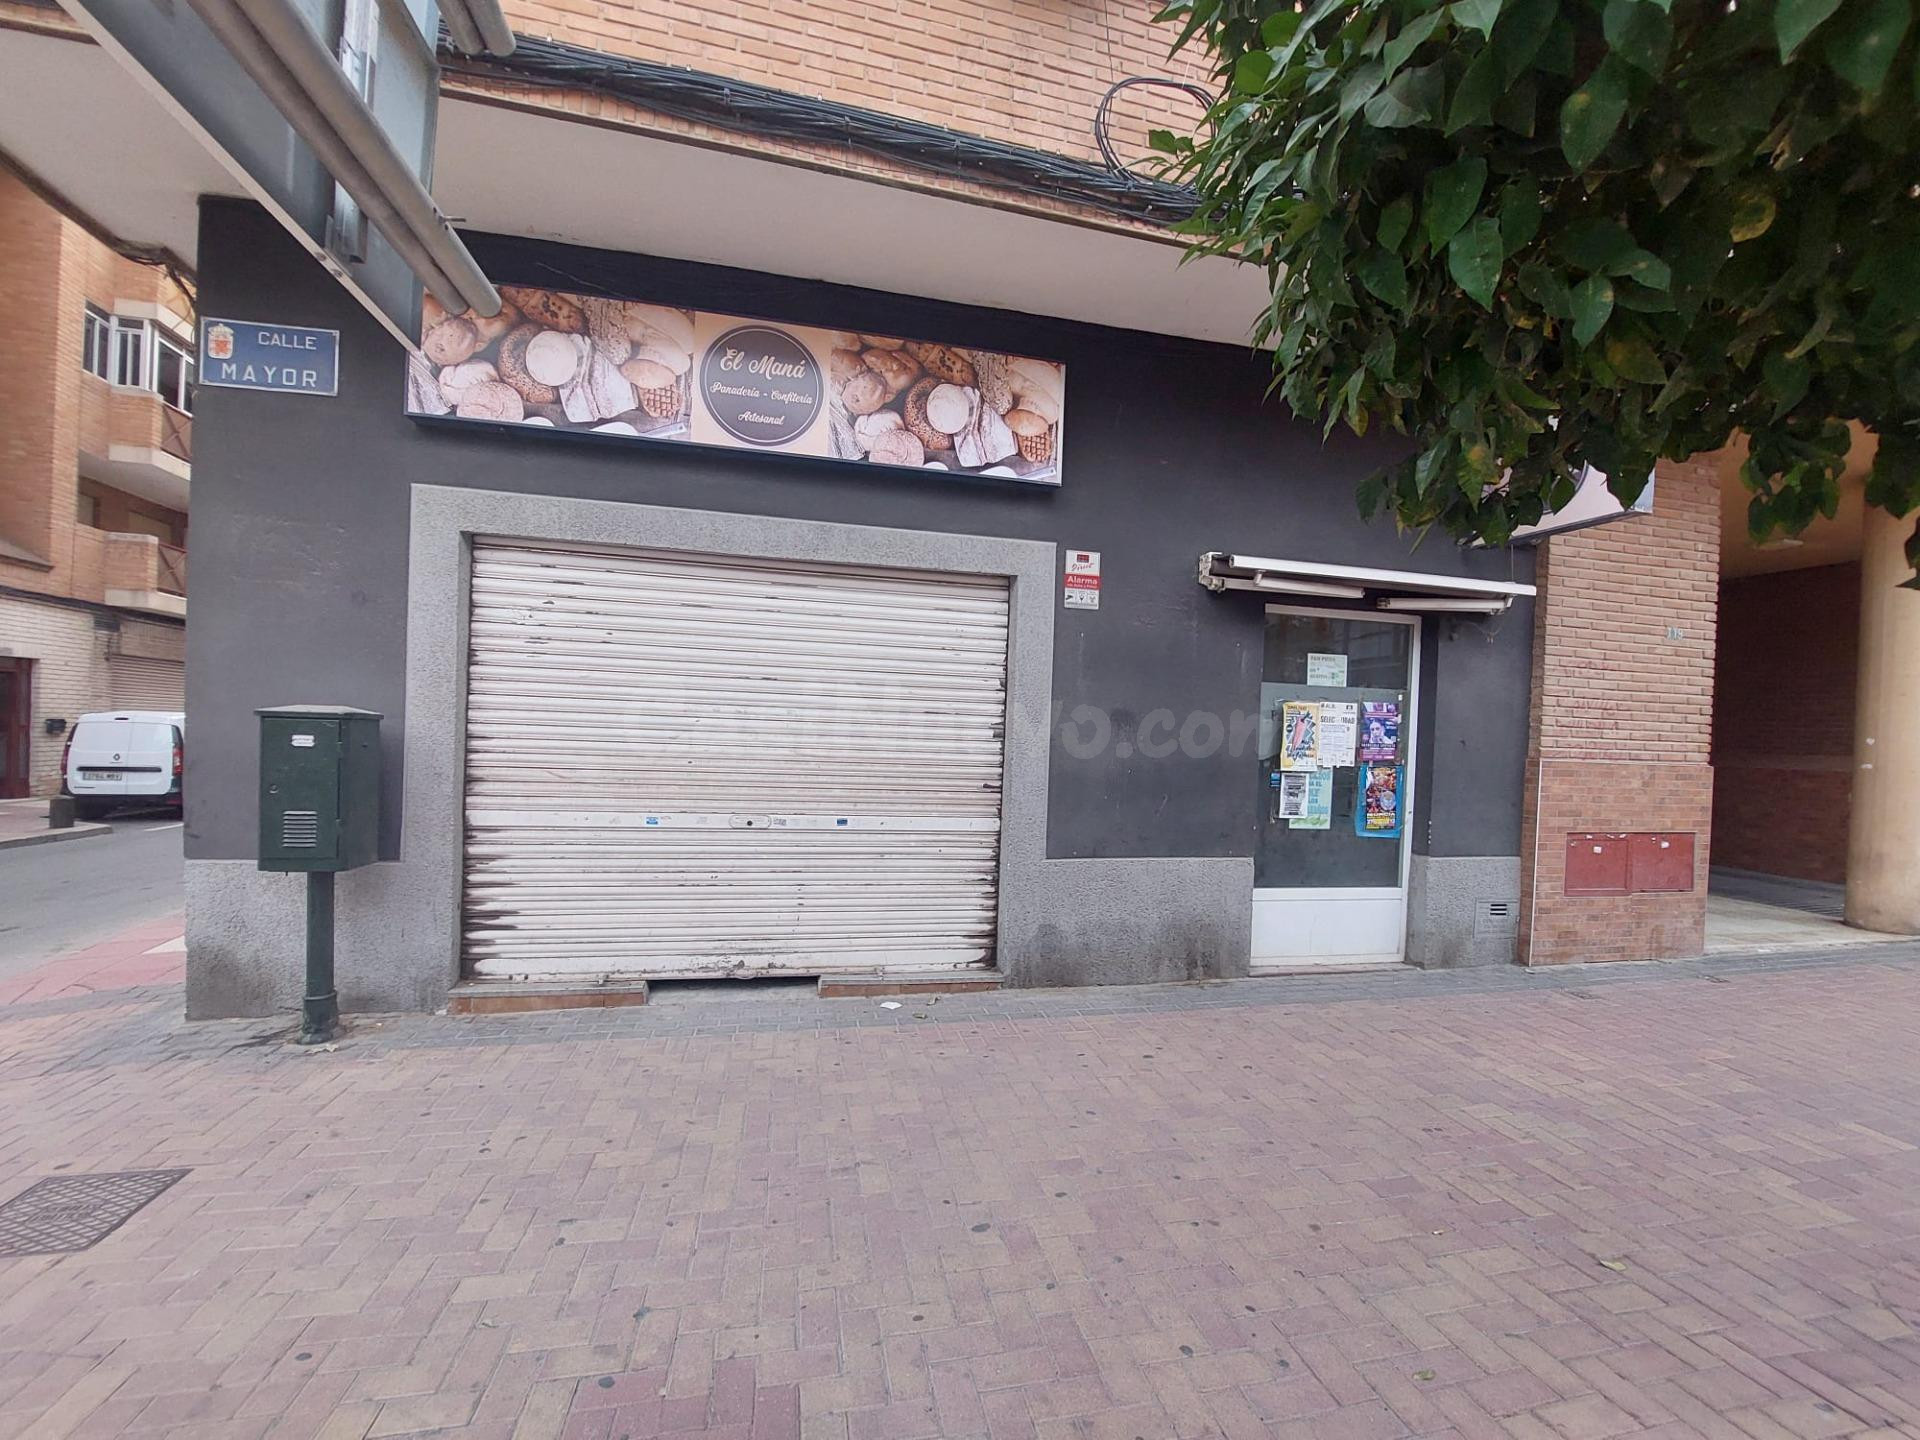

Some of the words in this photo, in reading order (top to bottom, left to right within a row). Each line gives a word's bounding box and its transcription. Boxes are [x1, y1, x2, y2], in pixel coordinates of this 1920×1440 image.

[258, 331, 318, 350] CALLE
[720, 347, 745, 371] El
[748, 355, 806, 380] Maná
[221, 362, 317, 388] MAYOR
[737, 410, 785, 425] Artesanal
[1066, 575, 1099, 586] Alarma
